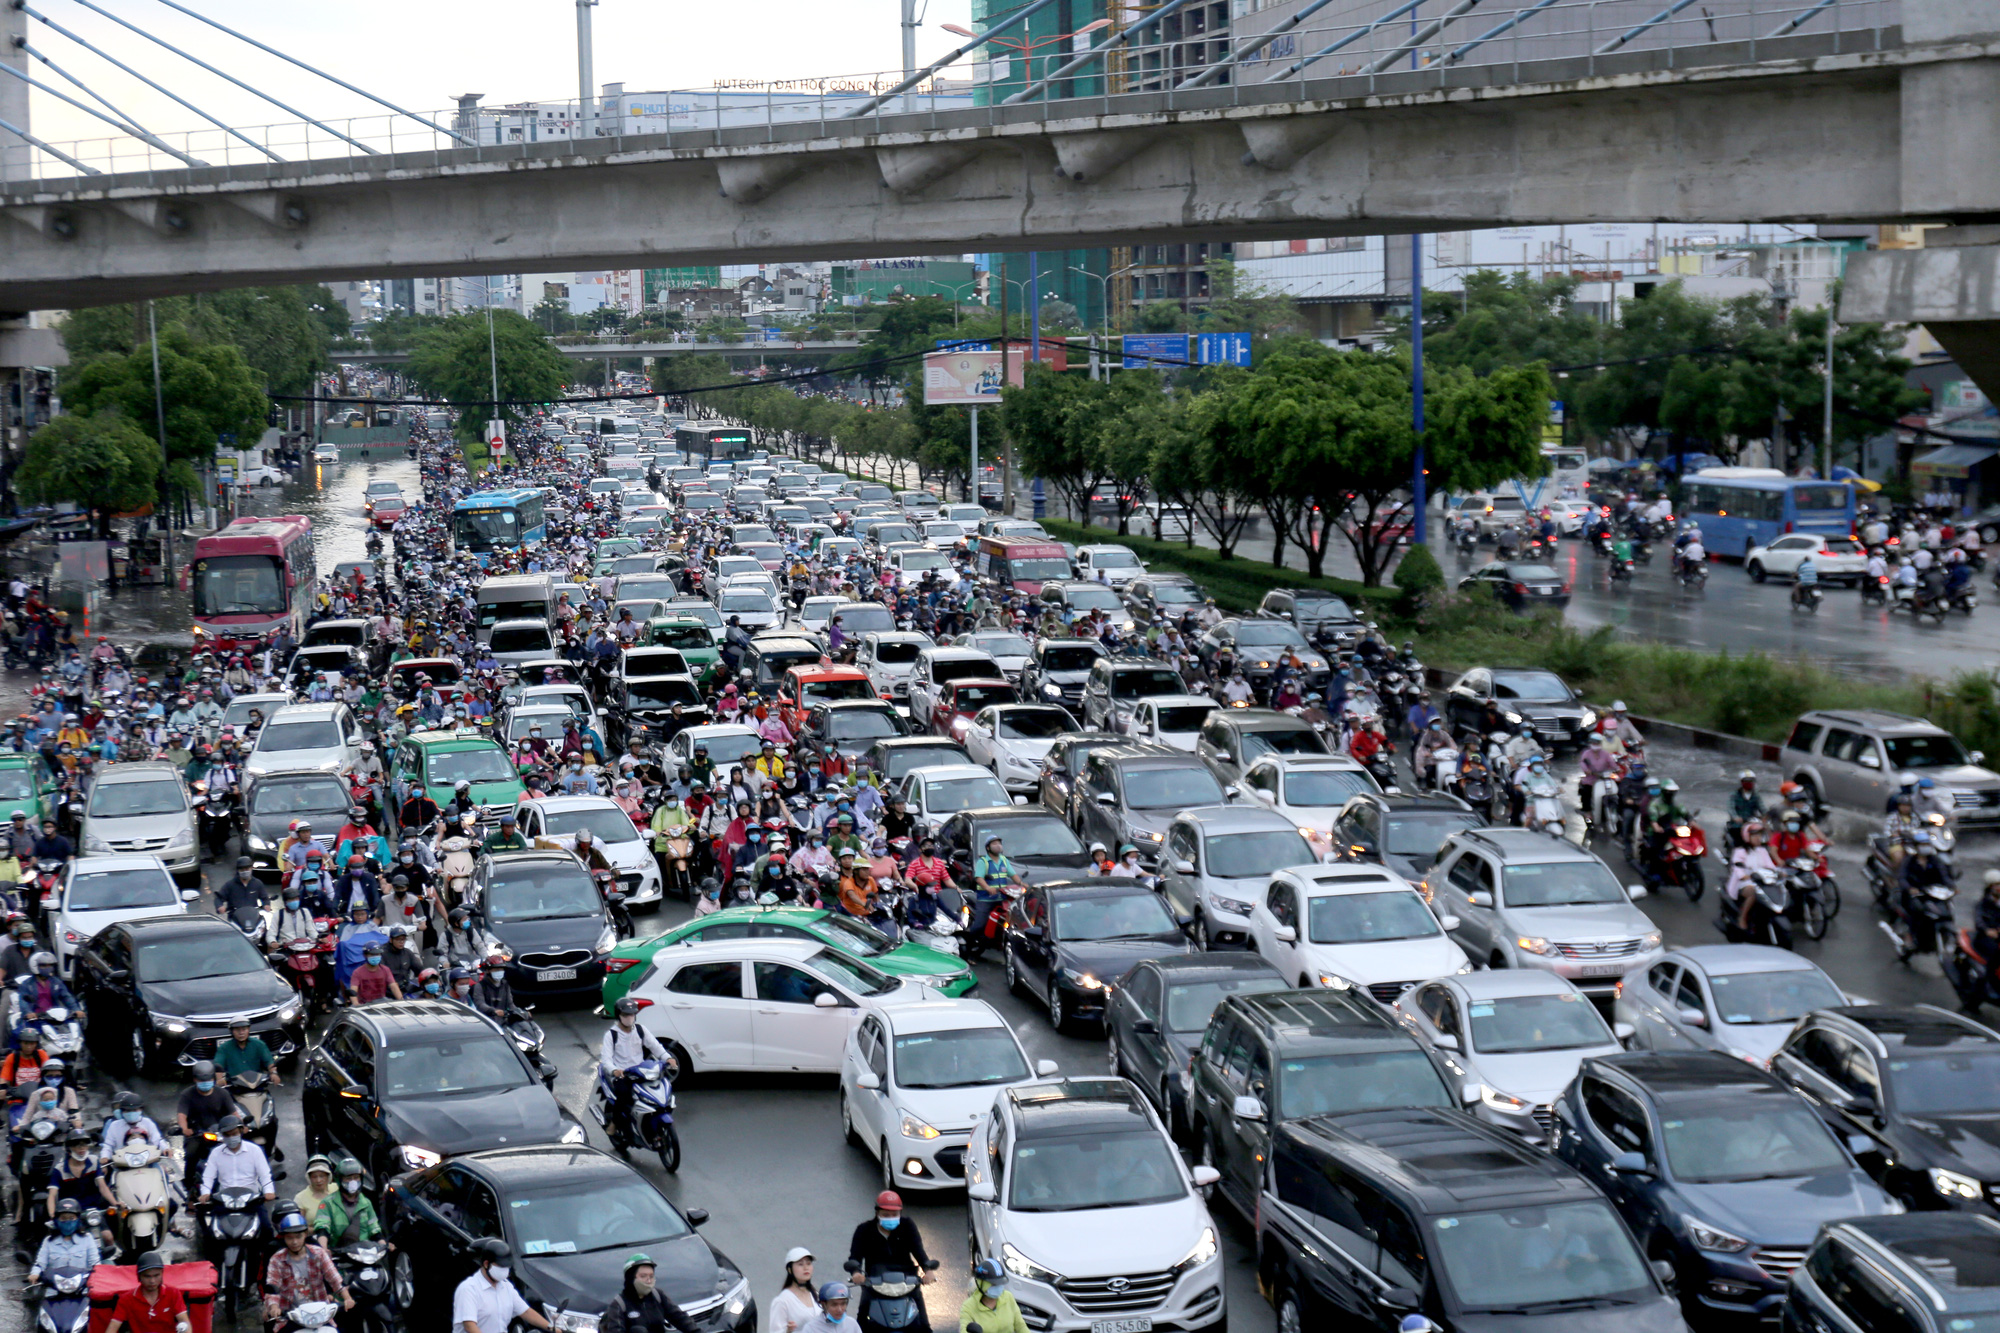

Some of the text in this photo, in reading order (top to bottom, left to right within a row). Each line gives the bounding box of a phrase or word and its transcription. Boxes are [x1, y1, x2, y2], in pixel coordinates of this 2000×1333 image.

[714, 79, 764, 89] HUTECH
[642, 104, 689, 114] HUTECH
[538, 119, 562, 128] HSBC
[874, 260, 925, 269] ALASKA
[539, 972, 550, 981] 51F
[1094, 1320, 1149, 1333] 51G 545.06
